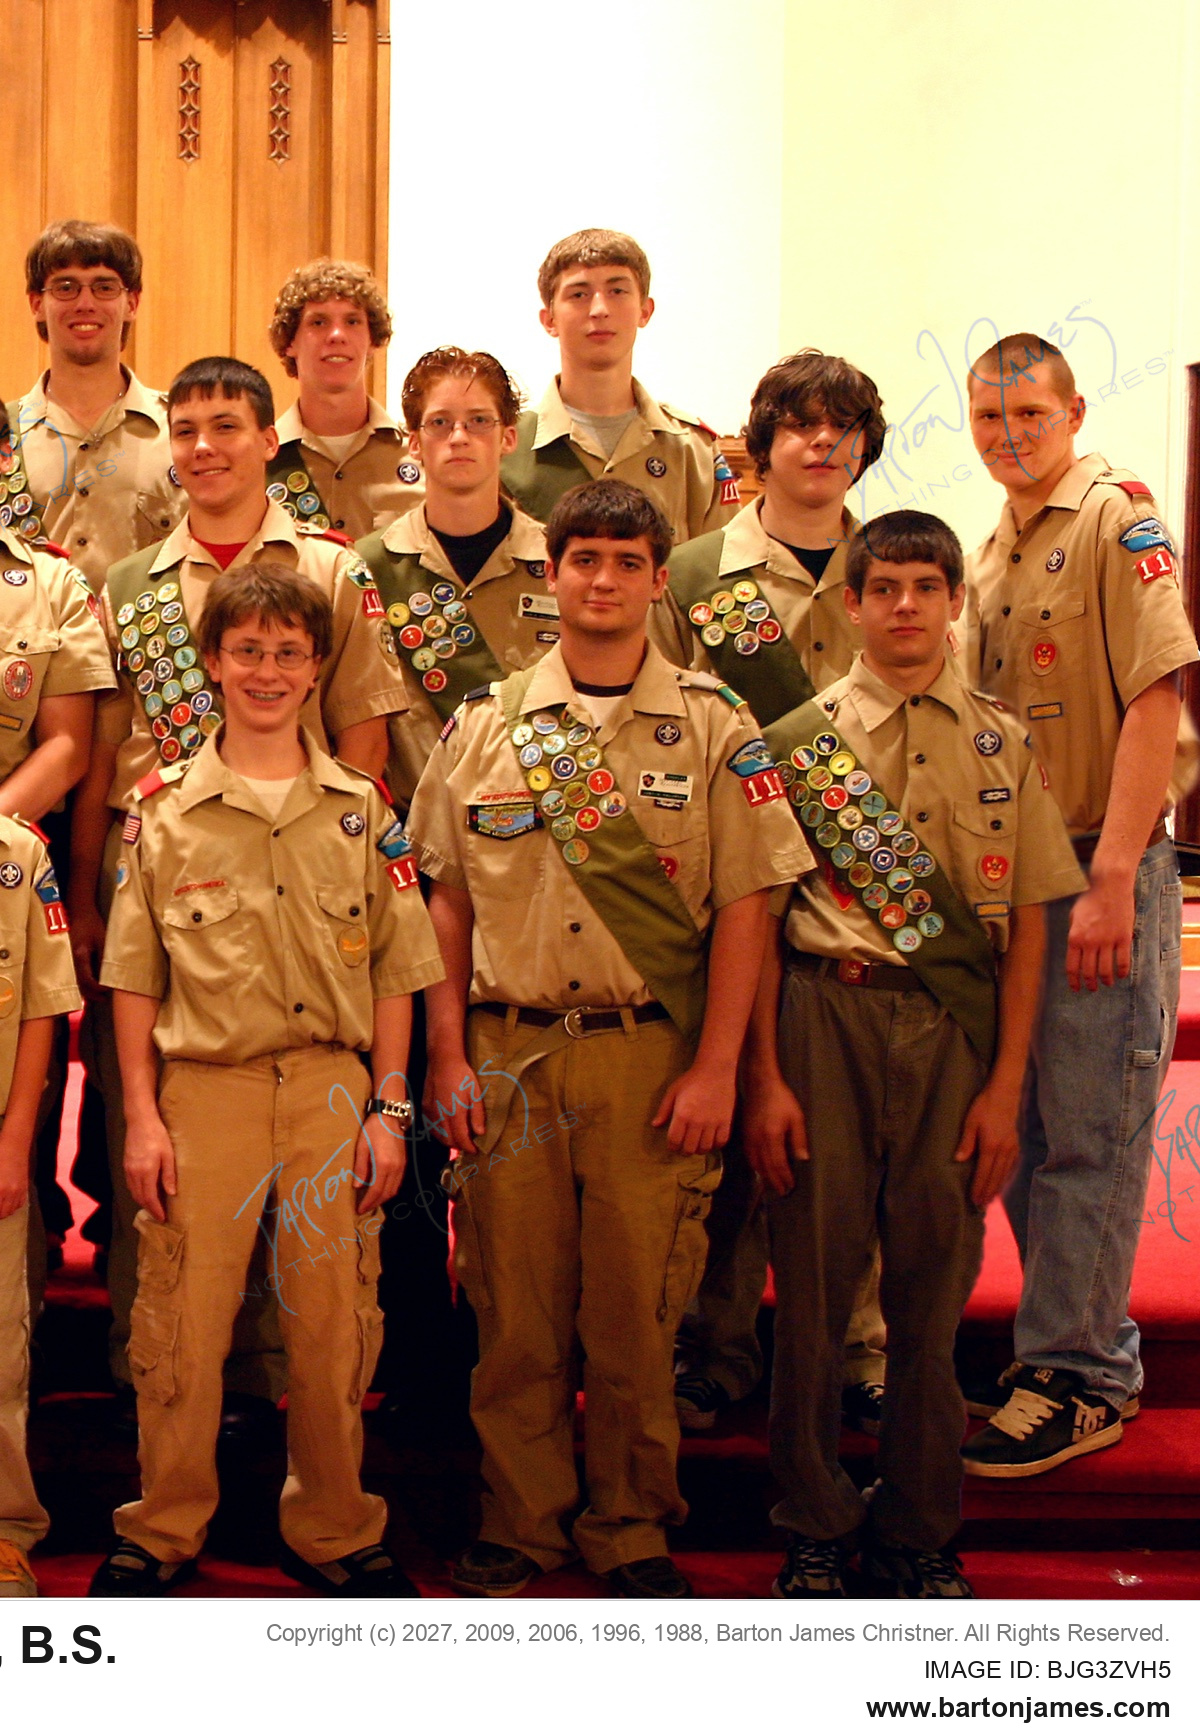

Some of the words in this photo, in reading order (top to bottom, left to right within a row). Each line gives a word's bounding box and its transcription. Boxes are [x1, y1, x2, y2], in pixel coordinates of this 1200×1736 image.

[723, 482, 740, 502] 11
[1140, 553, 1174, 580] 11
[365, 592, 384, 614] 11
[392, 861, 417, 888] 11
